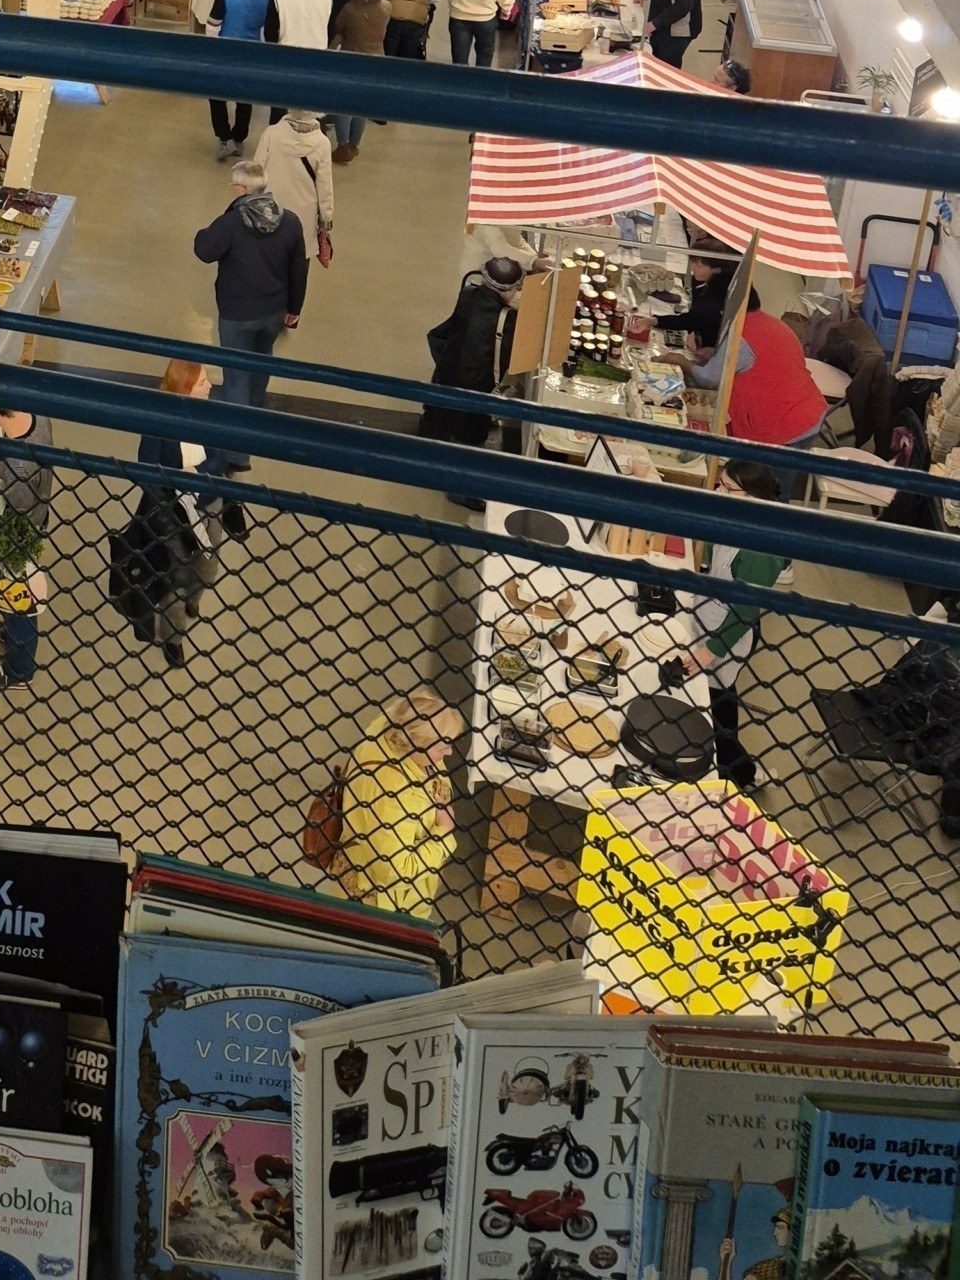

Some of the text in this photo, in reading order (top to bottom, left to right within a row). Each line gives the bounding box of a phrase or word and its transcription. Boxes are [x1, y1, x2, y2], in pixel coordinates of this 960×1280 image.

[192, 987, 230, 1005] ZLATÁ
[236, 988, 286, 999] ZBIERKA
[196, 1039, 212, 1059] V
[214, 1071, 223, 1081] a
[230, 1070, 253, 1085] iné
[706, 1112, 767, 1131] STARÉ
[753, 1137, 766, 1150] A
[827, 1131, 877, 1154] Moja
[823, 1158, 841, 1177] o
[0, 1187, 74, 1216] obloha
[2, 1215, 8, 1223] a
[13, 1225, 44, 1239] oblohy
